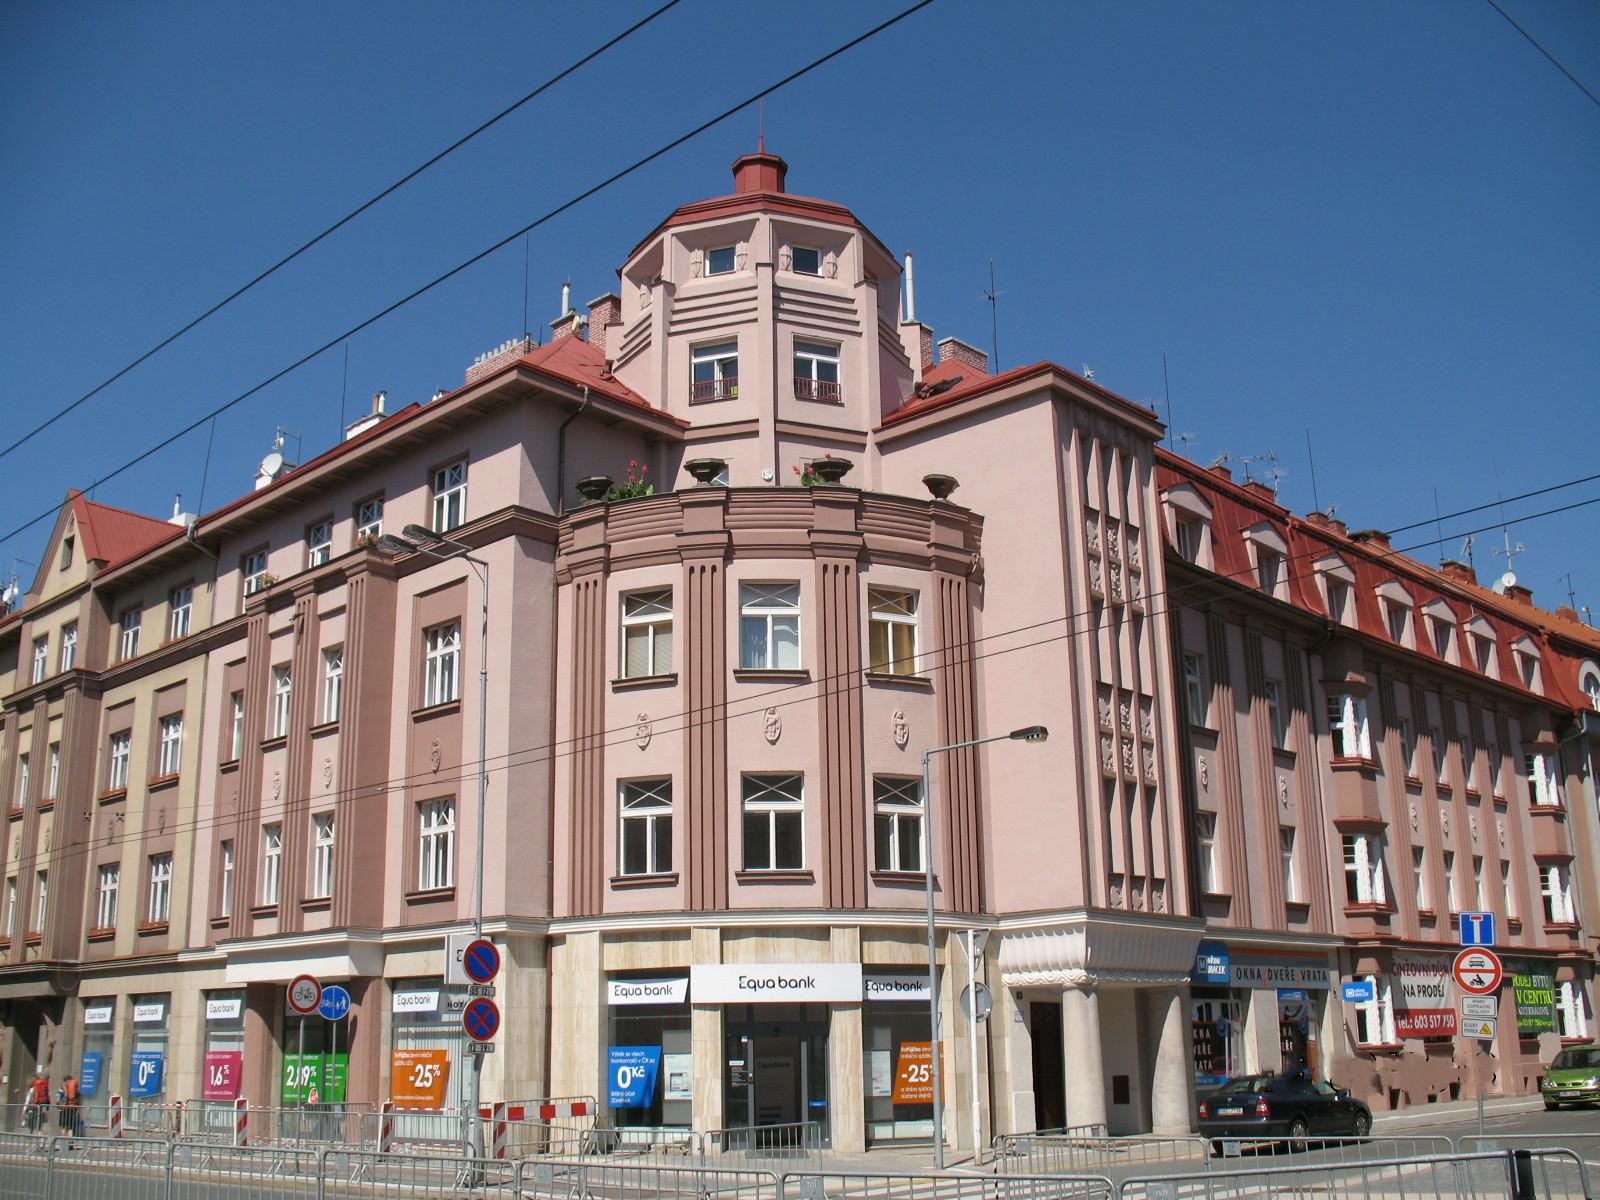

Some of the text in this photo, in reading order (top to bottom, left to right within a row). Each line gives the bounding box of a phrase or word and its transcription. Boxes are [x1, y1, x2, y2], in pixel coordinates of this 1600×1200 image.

[1236, 966, 1327, 982] OKNA DVEŘE VRATA
[738, 975, 816, 992] Equa bank
[865, 980, 923, 994] Equa bank
[614, 984, 673, 998] Equa bank
[1403, 984, 1445, 998] NA PRODEJ
[1523, 990, 1553, 1005] CENTRU
[397, 993, 432, 1006] Equa bank
[210, 1003, 234, 1014] Equa bank
[1397, 1014, 1456, 1029] Tel.: 603 517 750
[409, 1063, 441, 1088] -25%
